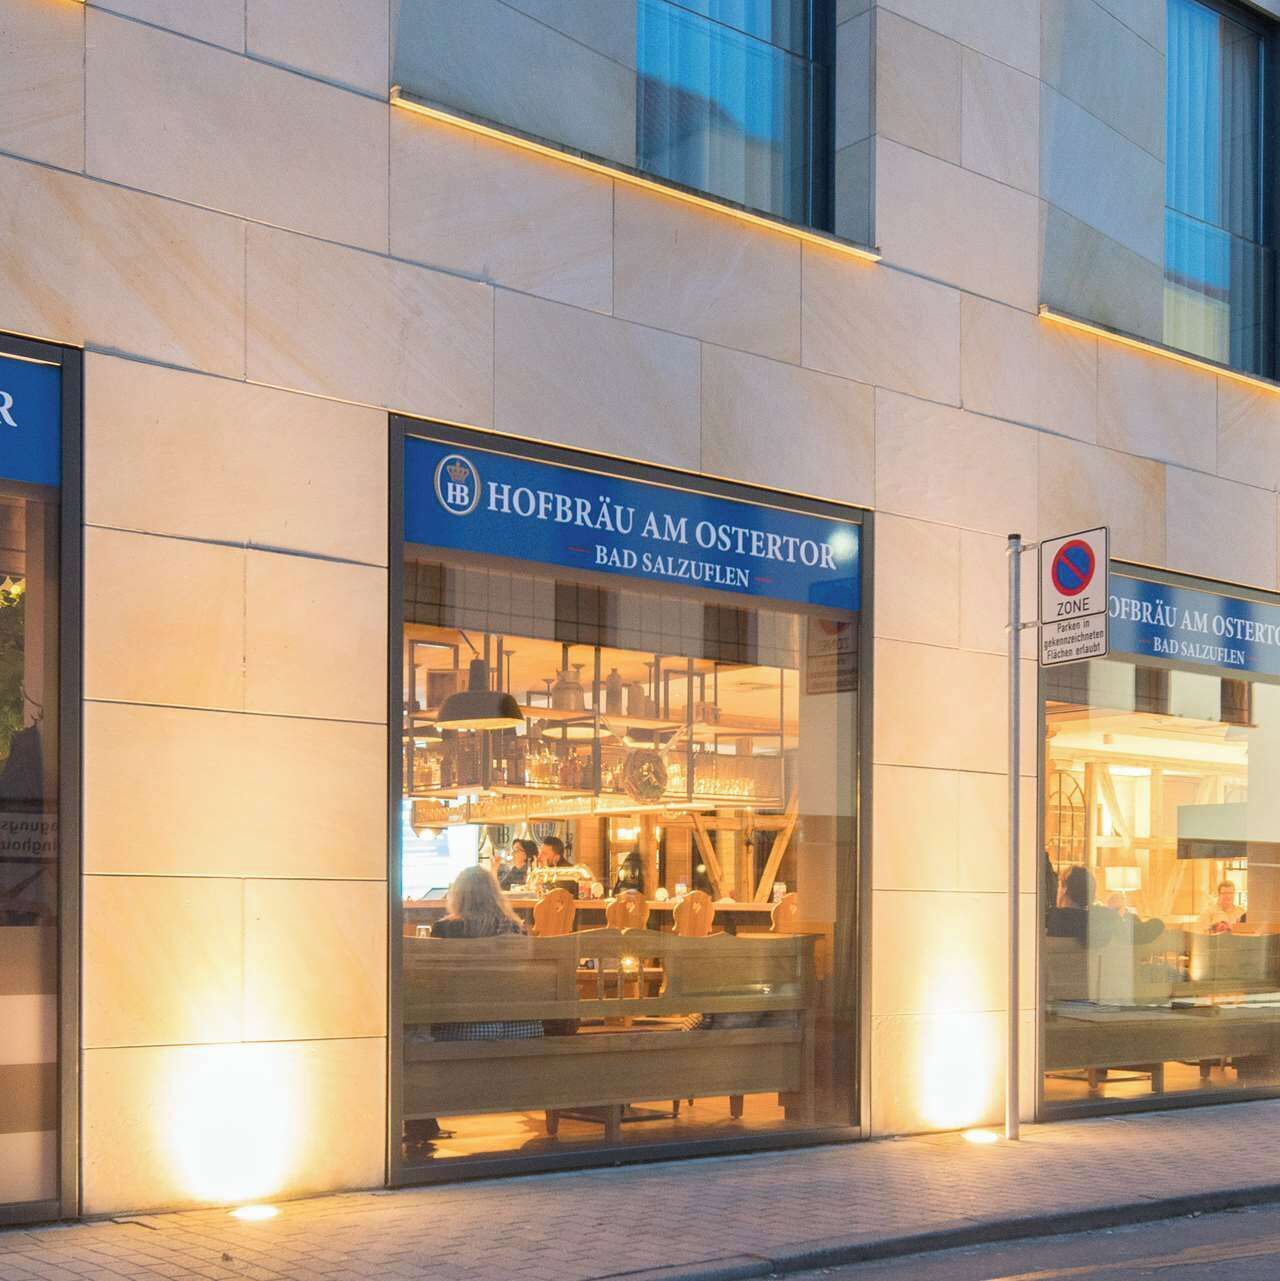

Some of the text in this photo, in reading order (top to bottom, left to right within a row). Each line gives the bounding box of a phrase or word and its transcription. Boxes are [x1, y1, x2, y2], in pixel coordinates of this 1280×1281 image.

[447, 482, 470, 506] HB
[487, 481, 837, 570] HOFBRÄU AM OSTERTOR
[594, 544, 750, 588] BAD SALZUFLEN
[1057, 596, 1090, 616] ZONE
[1108, 595, 1178, 628] OFBRÄU
[1180, 609, 1209, 634] AM
[1056, 619, 1090, 633] Parken in
[1043, 630, 1104, 651] gekennzeichneten
[1046, 642, 1100, 660] Flächen erlaubt
[1153, 636, 1246, 665] BAD SALZUFLEN
